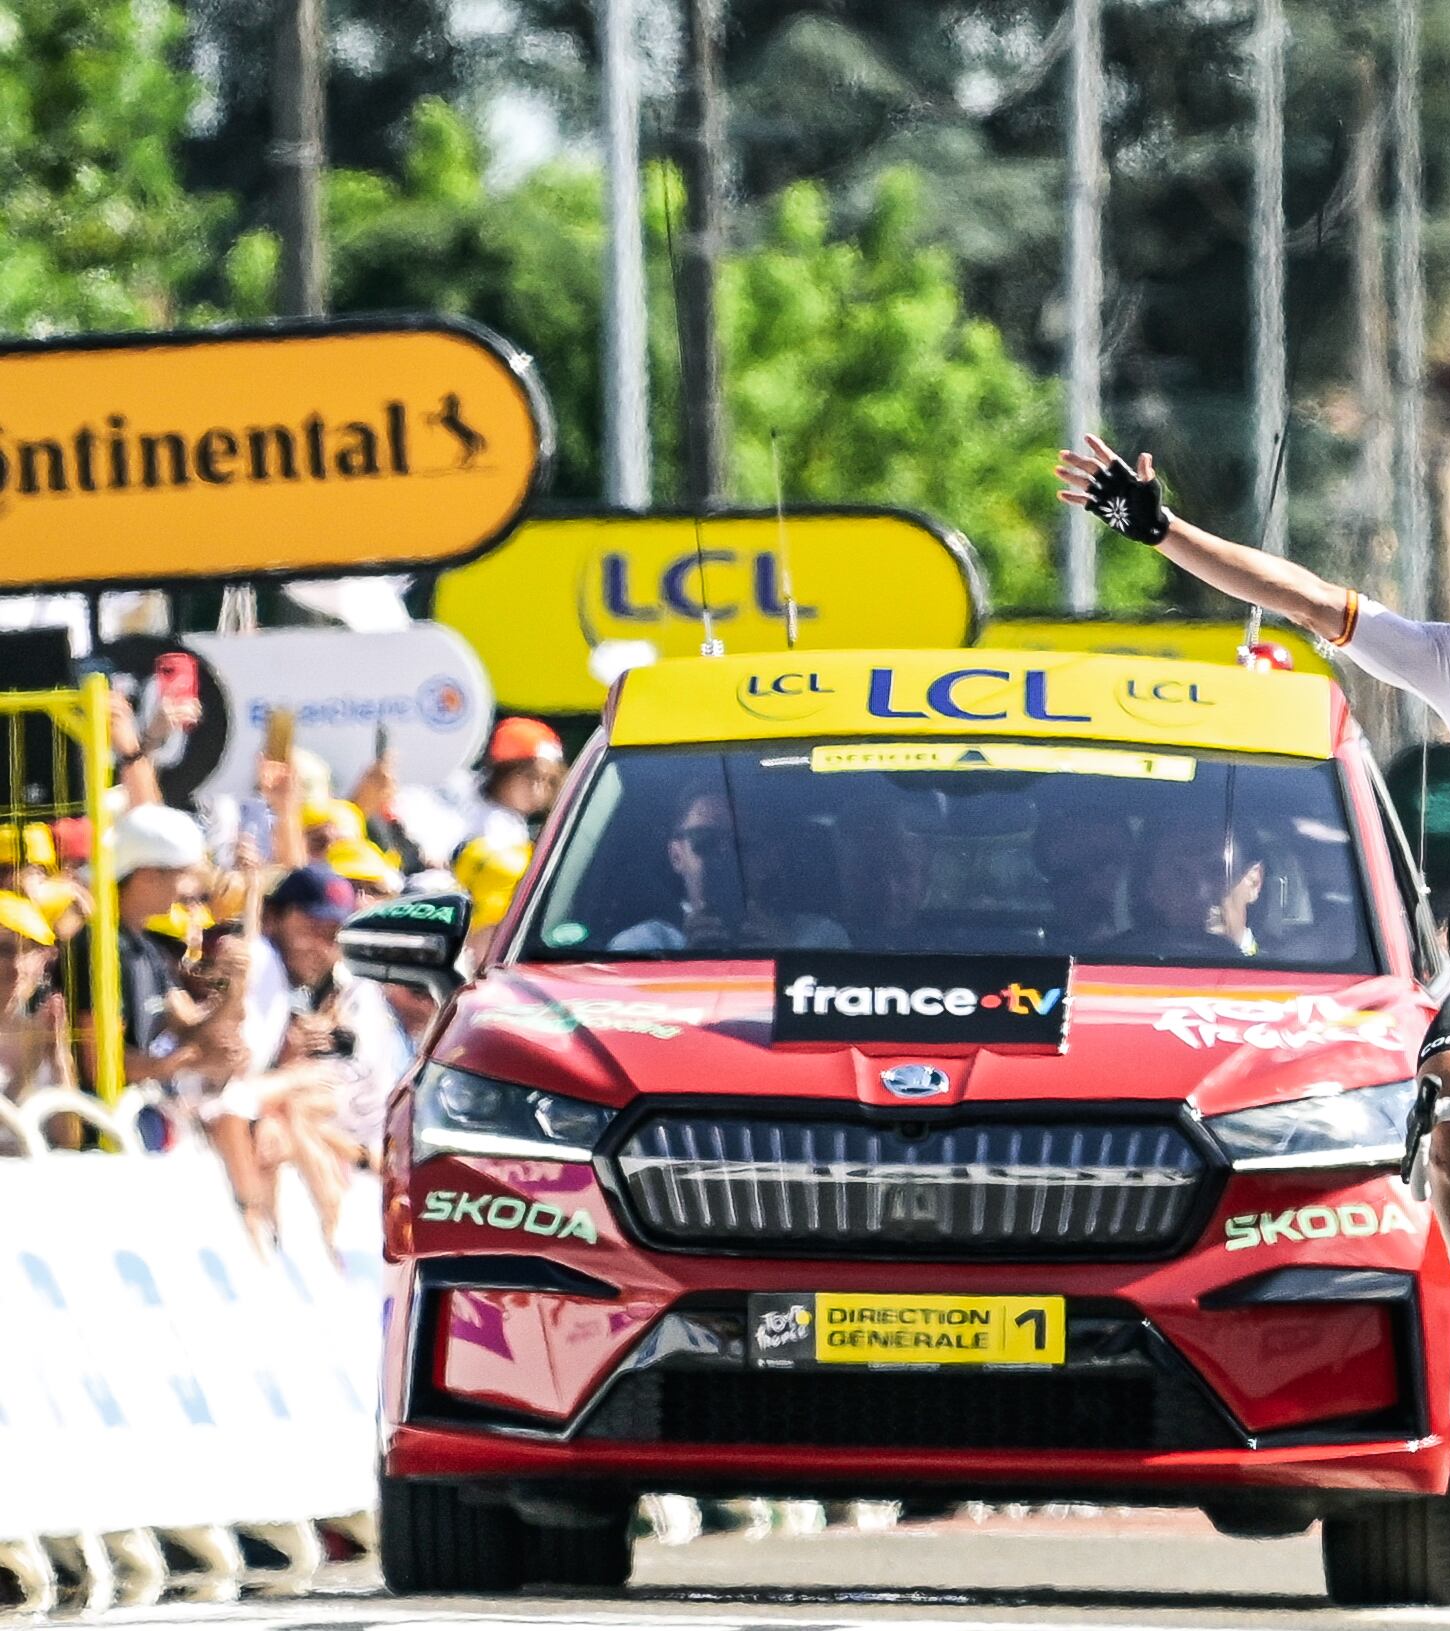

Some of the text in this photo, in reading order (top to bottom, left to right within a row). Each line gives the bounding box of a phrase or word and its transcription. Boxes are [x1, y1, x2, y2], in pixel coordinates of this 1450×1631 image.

[0, 401, 411, 498] ntinental
[602, 550, 817, 620] LCL
[748, 672, 836, 697] LCL
[867, 667, 1092, 723] LCL
[1126, 679, 1217, 706] LCL
[418, 1190, 598, 1245] SKODA
[1225, 1203, 1419, 1251] SKODA
[827, 1307, 991, 1325] DIRECTION
[1014, 1308, 1047, 1350] 1
